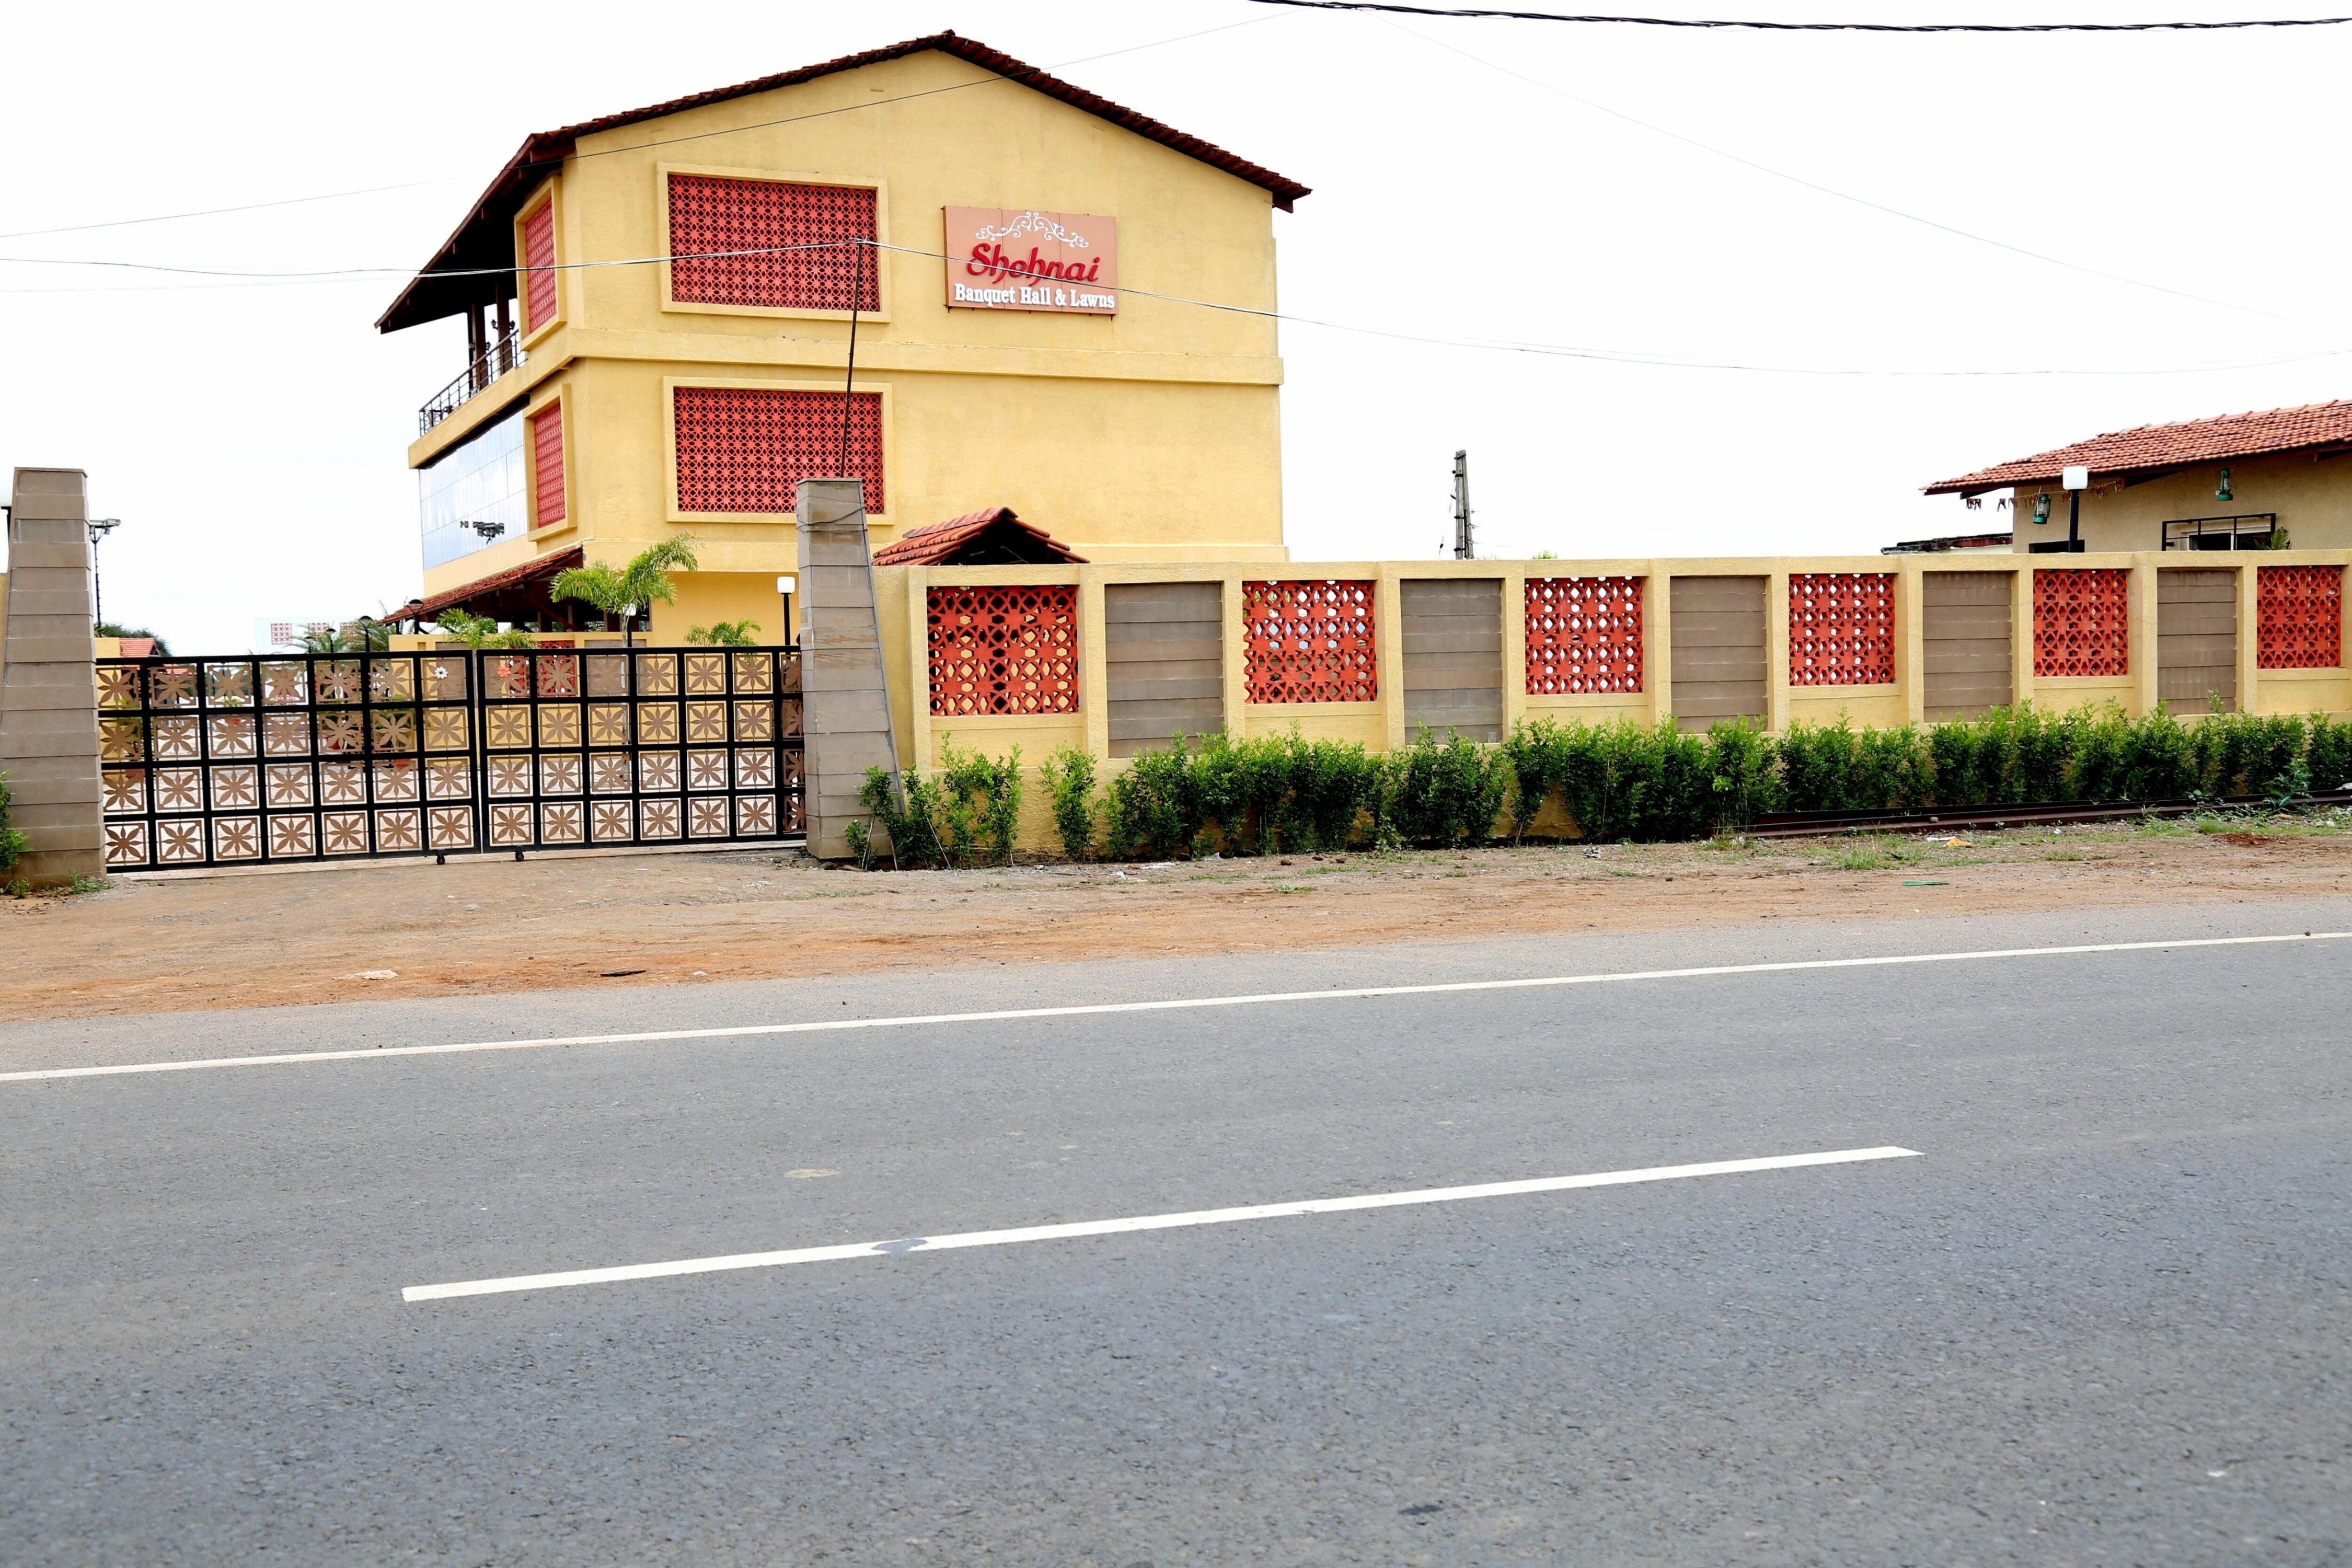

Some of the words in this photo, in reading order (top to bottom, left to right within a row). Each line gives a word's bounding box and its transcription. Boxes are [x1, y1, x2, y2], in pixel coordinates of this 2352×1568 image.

[967, 243, 1100, 286] Shehnai
[954, 283, 1016, 307] Banquet
[1020, 286, 1051, 306] Hall
[1055, 288, 1066, 306] &
[1069, 289, 1115, 308] Lawns
